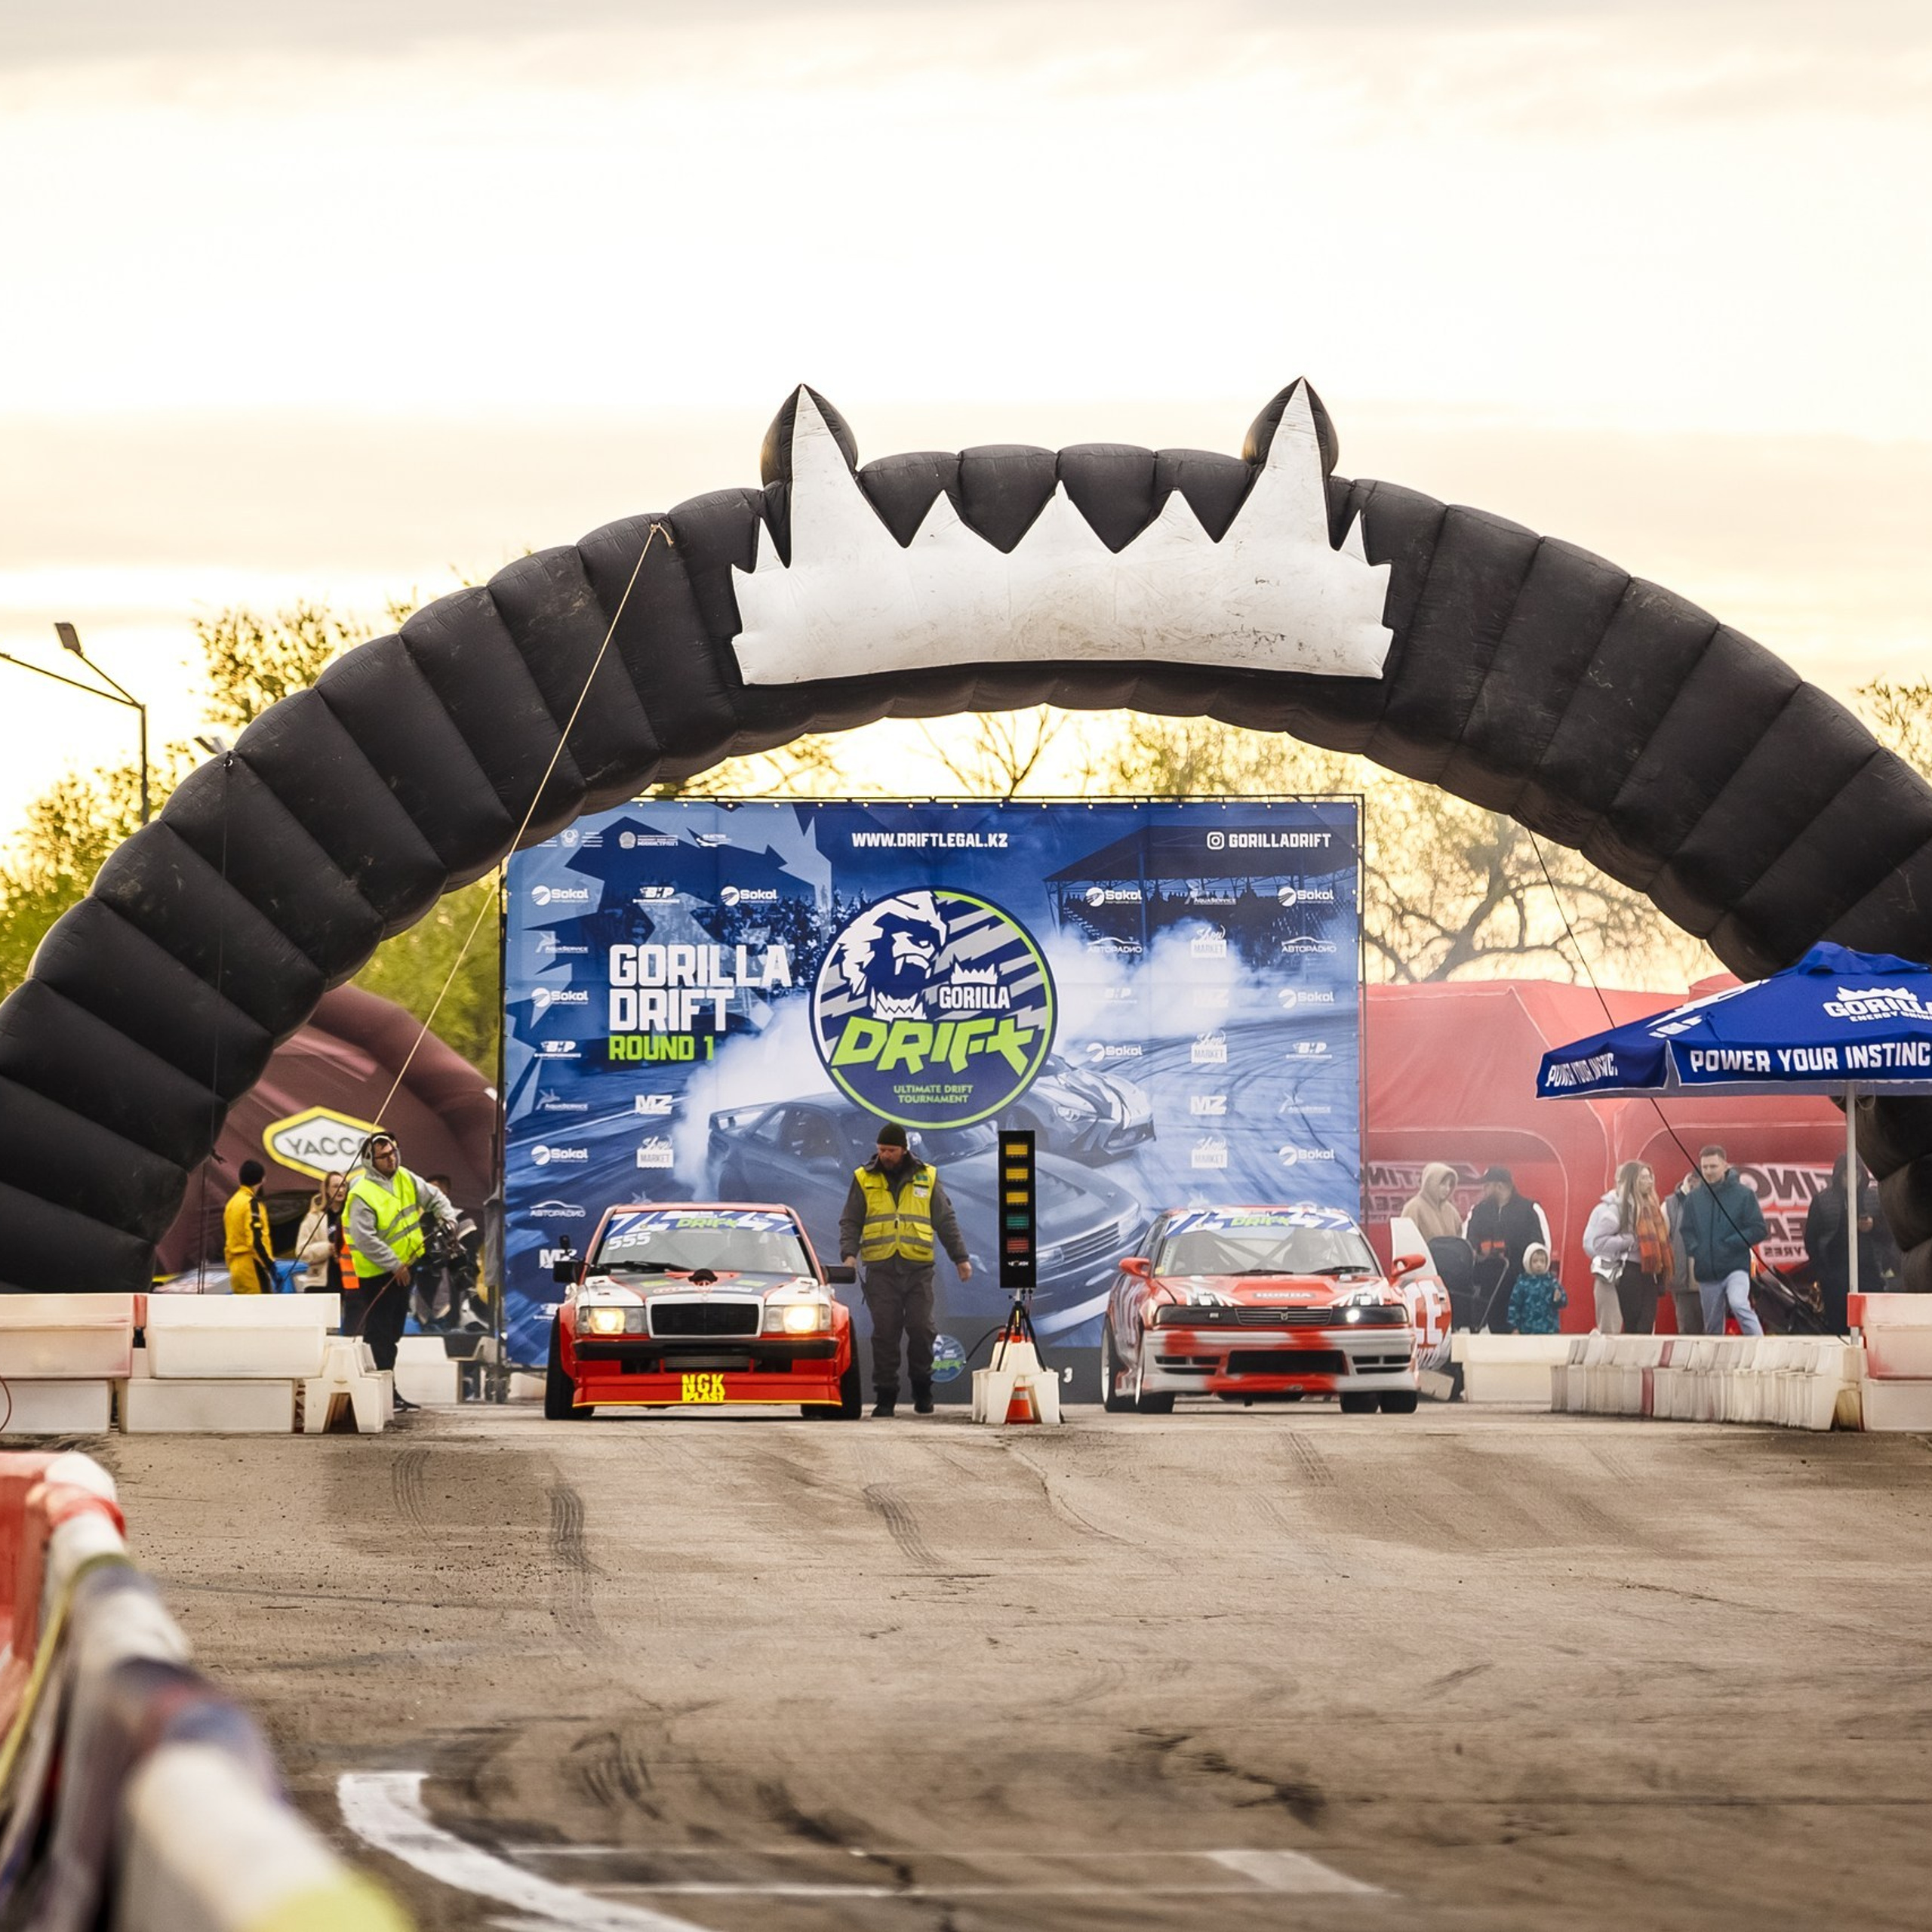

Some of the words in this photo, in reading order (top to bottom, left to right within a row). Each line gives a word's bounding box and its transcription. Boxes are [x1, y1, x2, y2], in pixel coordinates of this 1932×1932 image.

[852, 833, 1008, 848] WWW.DRIFTLEGAL.KZ
[1229, 833, 1331, 848] GORILLADRIFT
[551, 888, 589, 900] Sokol
[740, 889, 778, 900] Sokol
[1105, 889, 1143, 900] Sokol
[1297, 889, 1334, 900] Sokol
[610, 945, 792, 986] GORILLA
[551, 990, 589, 1001] Sokol
[940, 986, 1011, 1009] GORILLA
[1297, 991, 1334, 1002] Sokol
[609, 989, 735, 1031] DRIFT
[1823, 997, 1932, 1017] GORILL
[1849, 1011, 1897, 1022] ENERGY
[609, 1035, 695, 1060] ROUND
[703, 1035, 714, 1060] 1
[831, 1016, 1034, 1077] DRIFT
[1105, 1045, 1143, 1056] Sokol
[1690, 1050, 1770, 1072] POWER
[1777, 1047, 1838, 1072] YOUR
[893, 1084, 941, 1094] ULTIMATE
[944, 1084, 974, 1094] DRIFT
[898, 1094, 969, 1103] TOURNAMENT
[551, 1149, 589, 1159] Sokol
[1298, 1149, 1336, 1160] Sokol
[608, 1231, 652, 1251] 555
[681, 1374, 725, 1394] NGK
